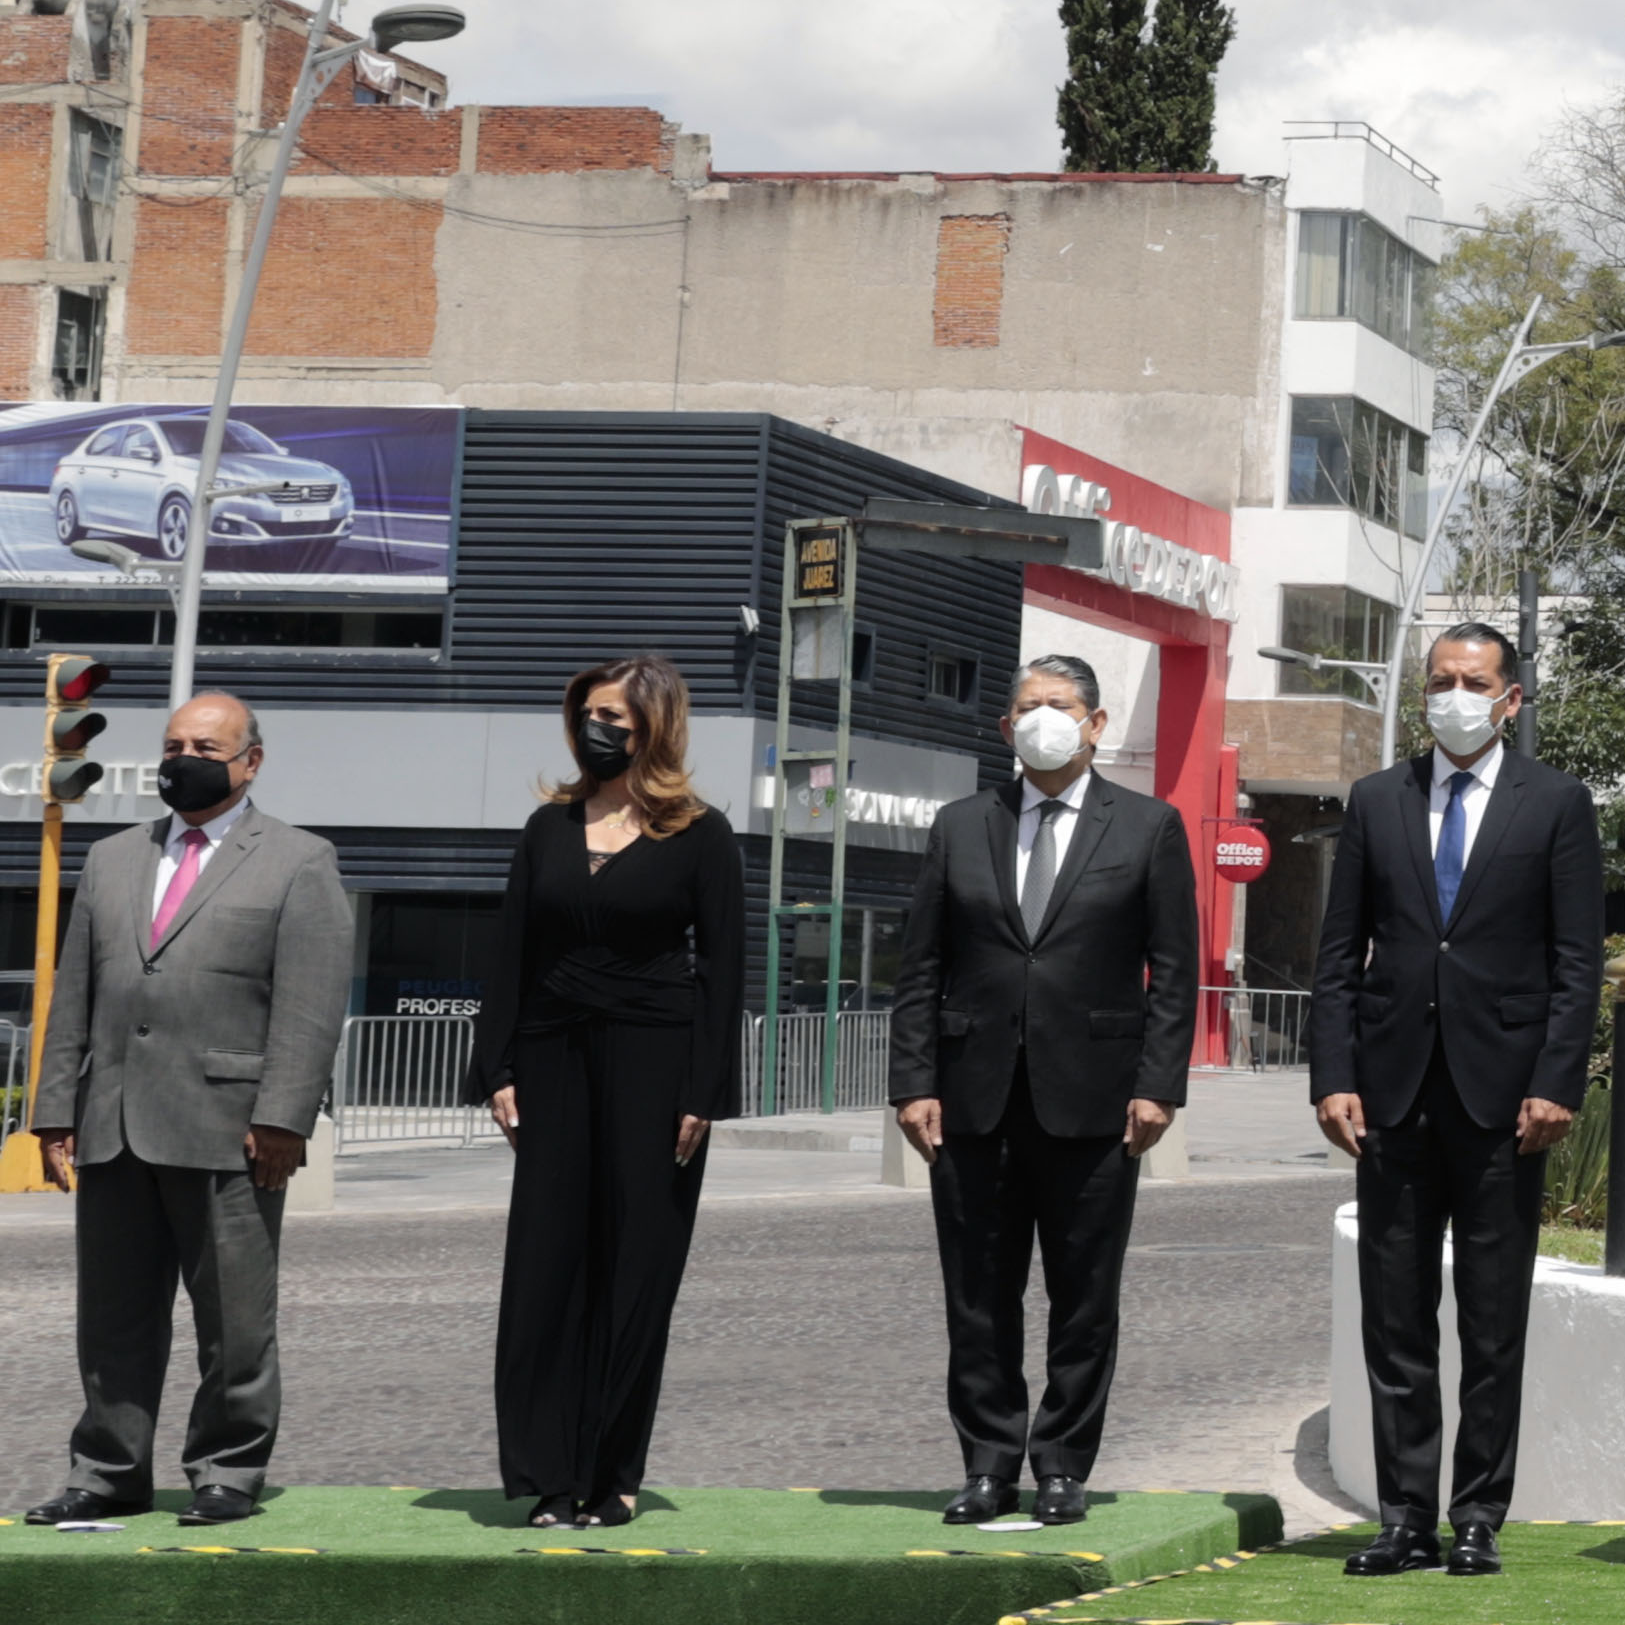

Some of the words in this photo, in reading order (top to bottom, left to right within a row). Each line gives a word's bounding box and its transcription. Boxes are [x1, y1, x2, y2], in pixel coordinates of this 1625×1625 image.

[801, 538, 836, 564] AVENIDA
[1139, 532, 1240, 624] DEPOT
[0, 762, 160, 796] CTE
[1216, 843, 1263, 856] Office
[1216, 856, 1263, 866] DEPOT
